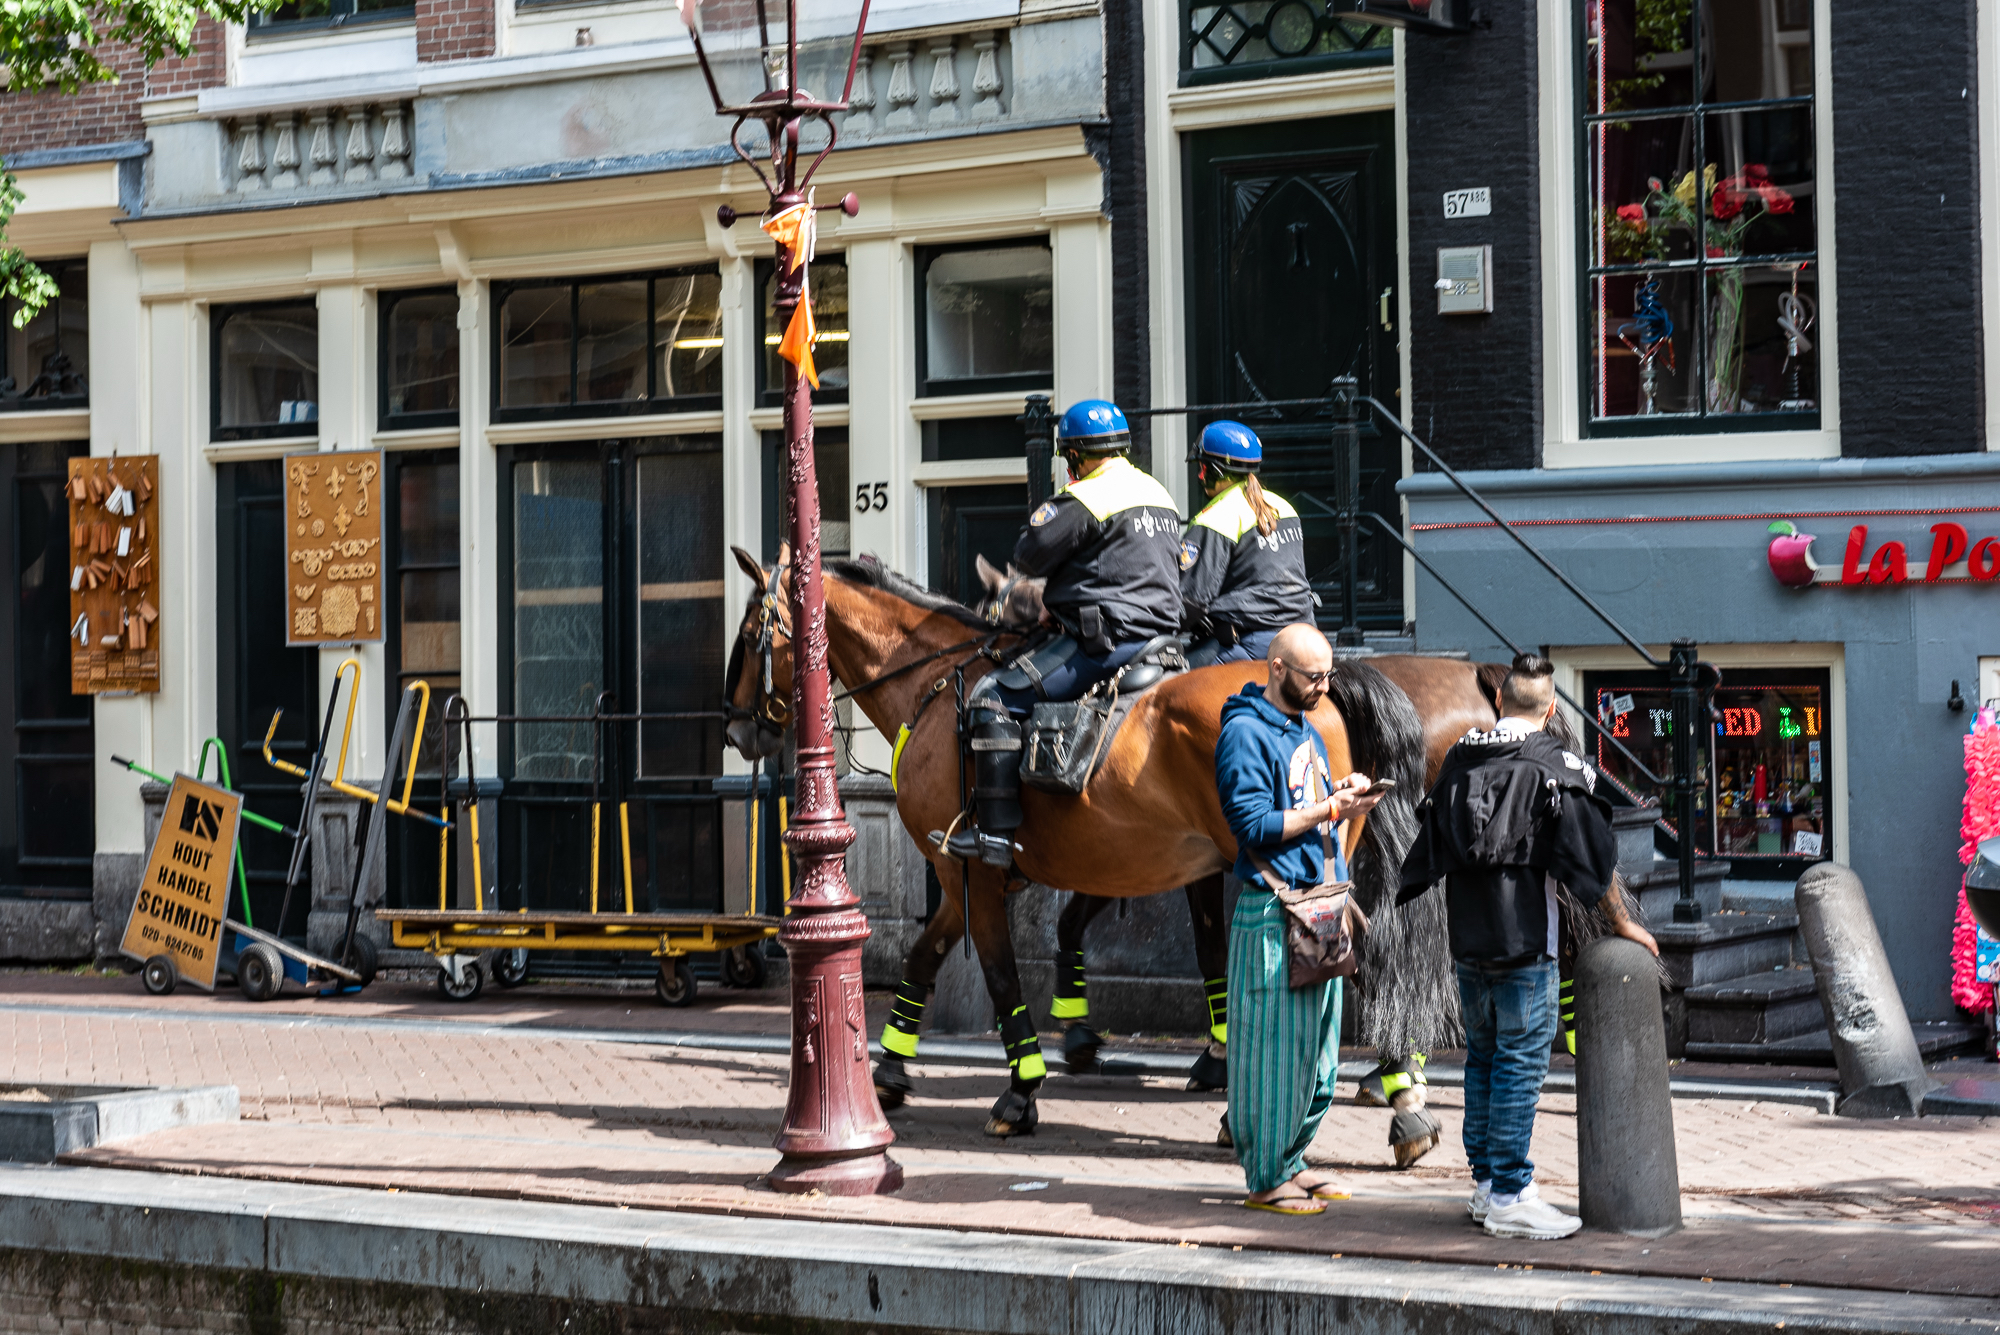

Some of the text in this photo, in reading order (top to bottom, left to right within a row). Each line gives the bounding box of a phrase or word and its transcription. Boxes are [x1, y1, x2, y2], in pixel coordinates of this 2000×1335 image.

[854, 481, 889, 513] 55
[1841, 521, 2000, 585] La Po
[1703, 707, 1762, 737] ED
[172, 840, 214, 872] HOUT
[157, 865, 213, 904] HANDEL
[138, 889, 221, 942] SCHMIDT
